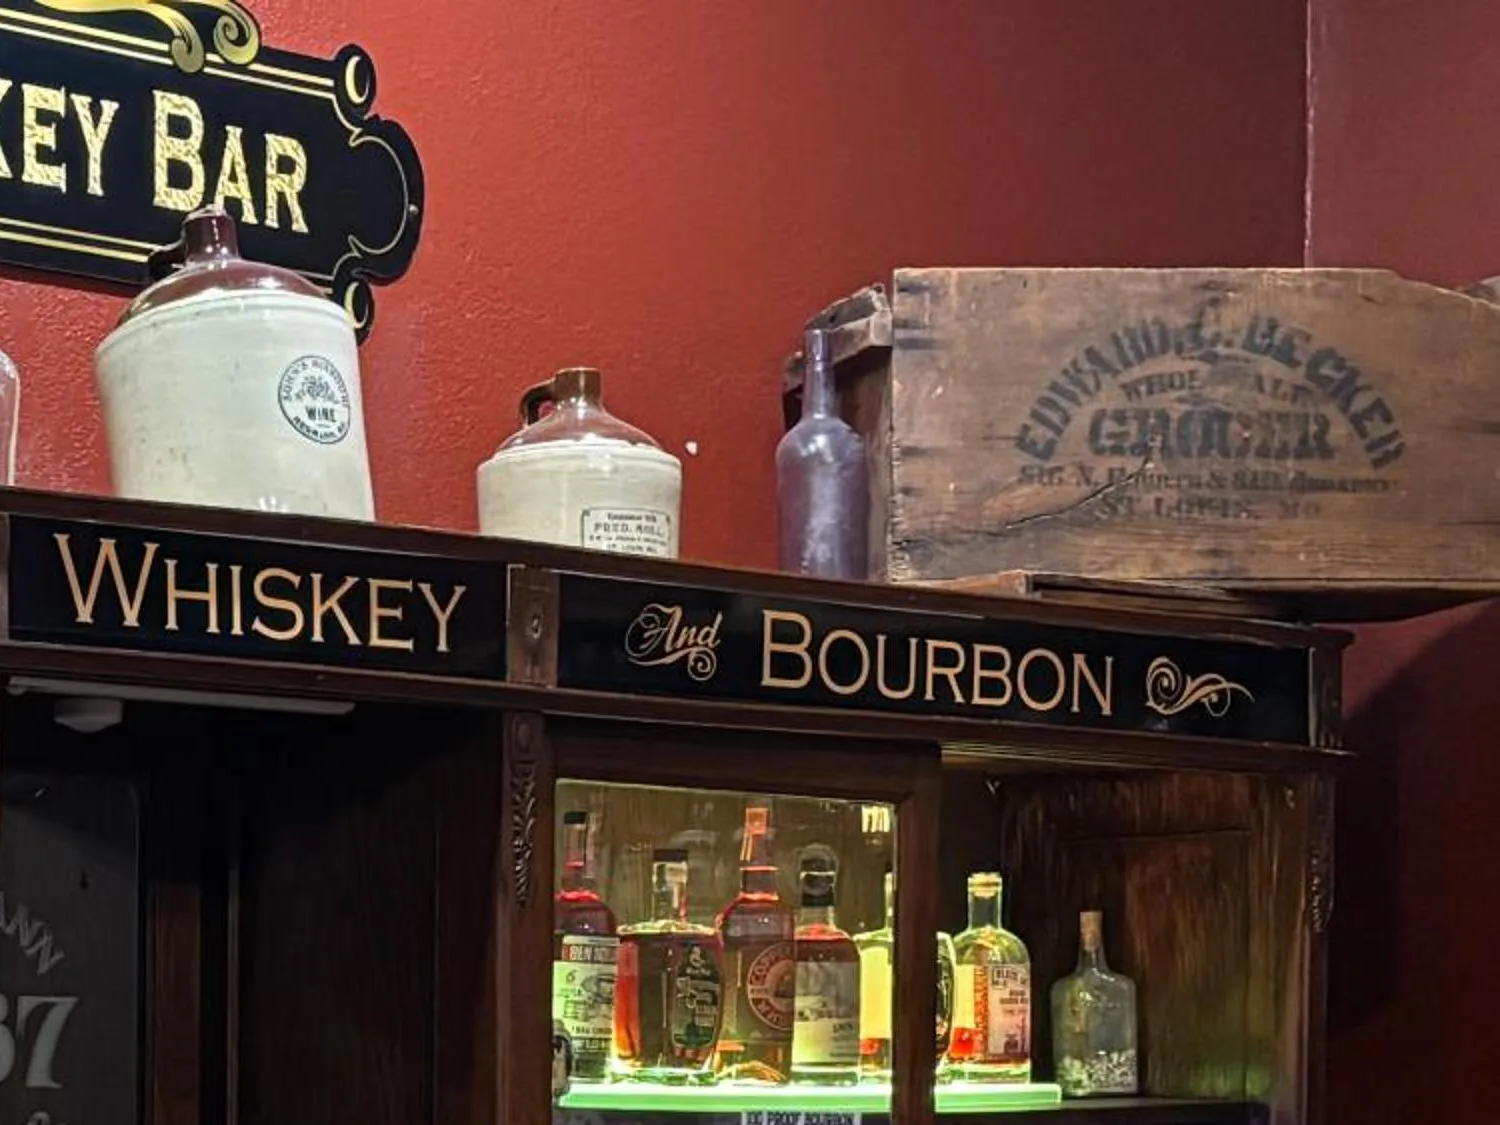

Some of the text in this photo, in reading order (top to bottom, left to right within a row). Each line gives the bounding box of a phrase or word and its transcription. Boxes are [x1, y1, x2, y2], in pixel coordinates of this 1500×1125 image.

[150, 88, 311, 235] BAR
[51, 532, 467, 655] WHISKEY
[625, 602, 1114, 717] And BOURBON
